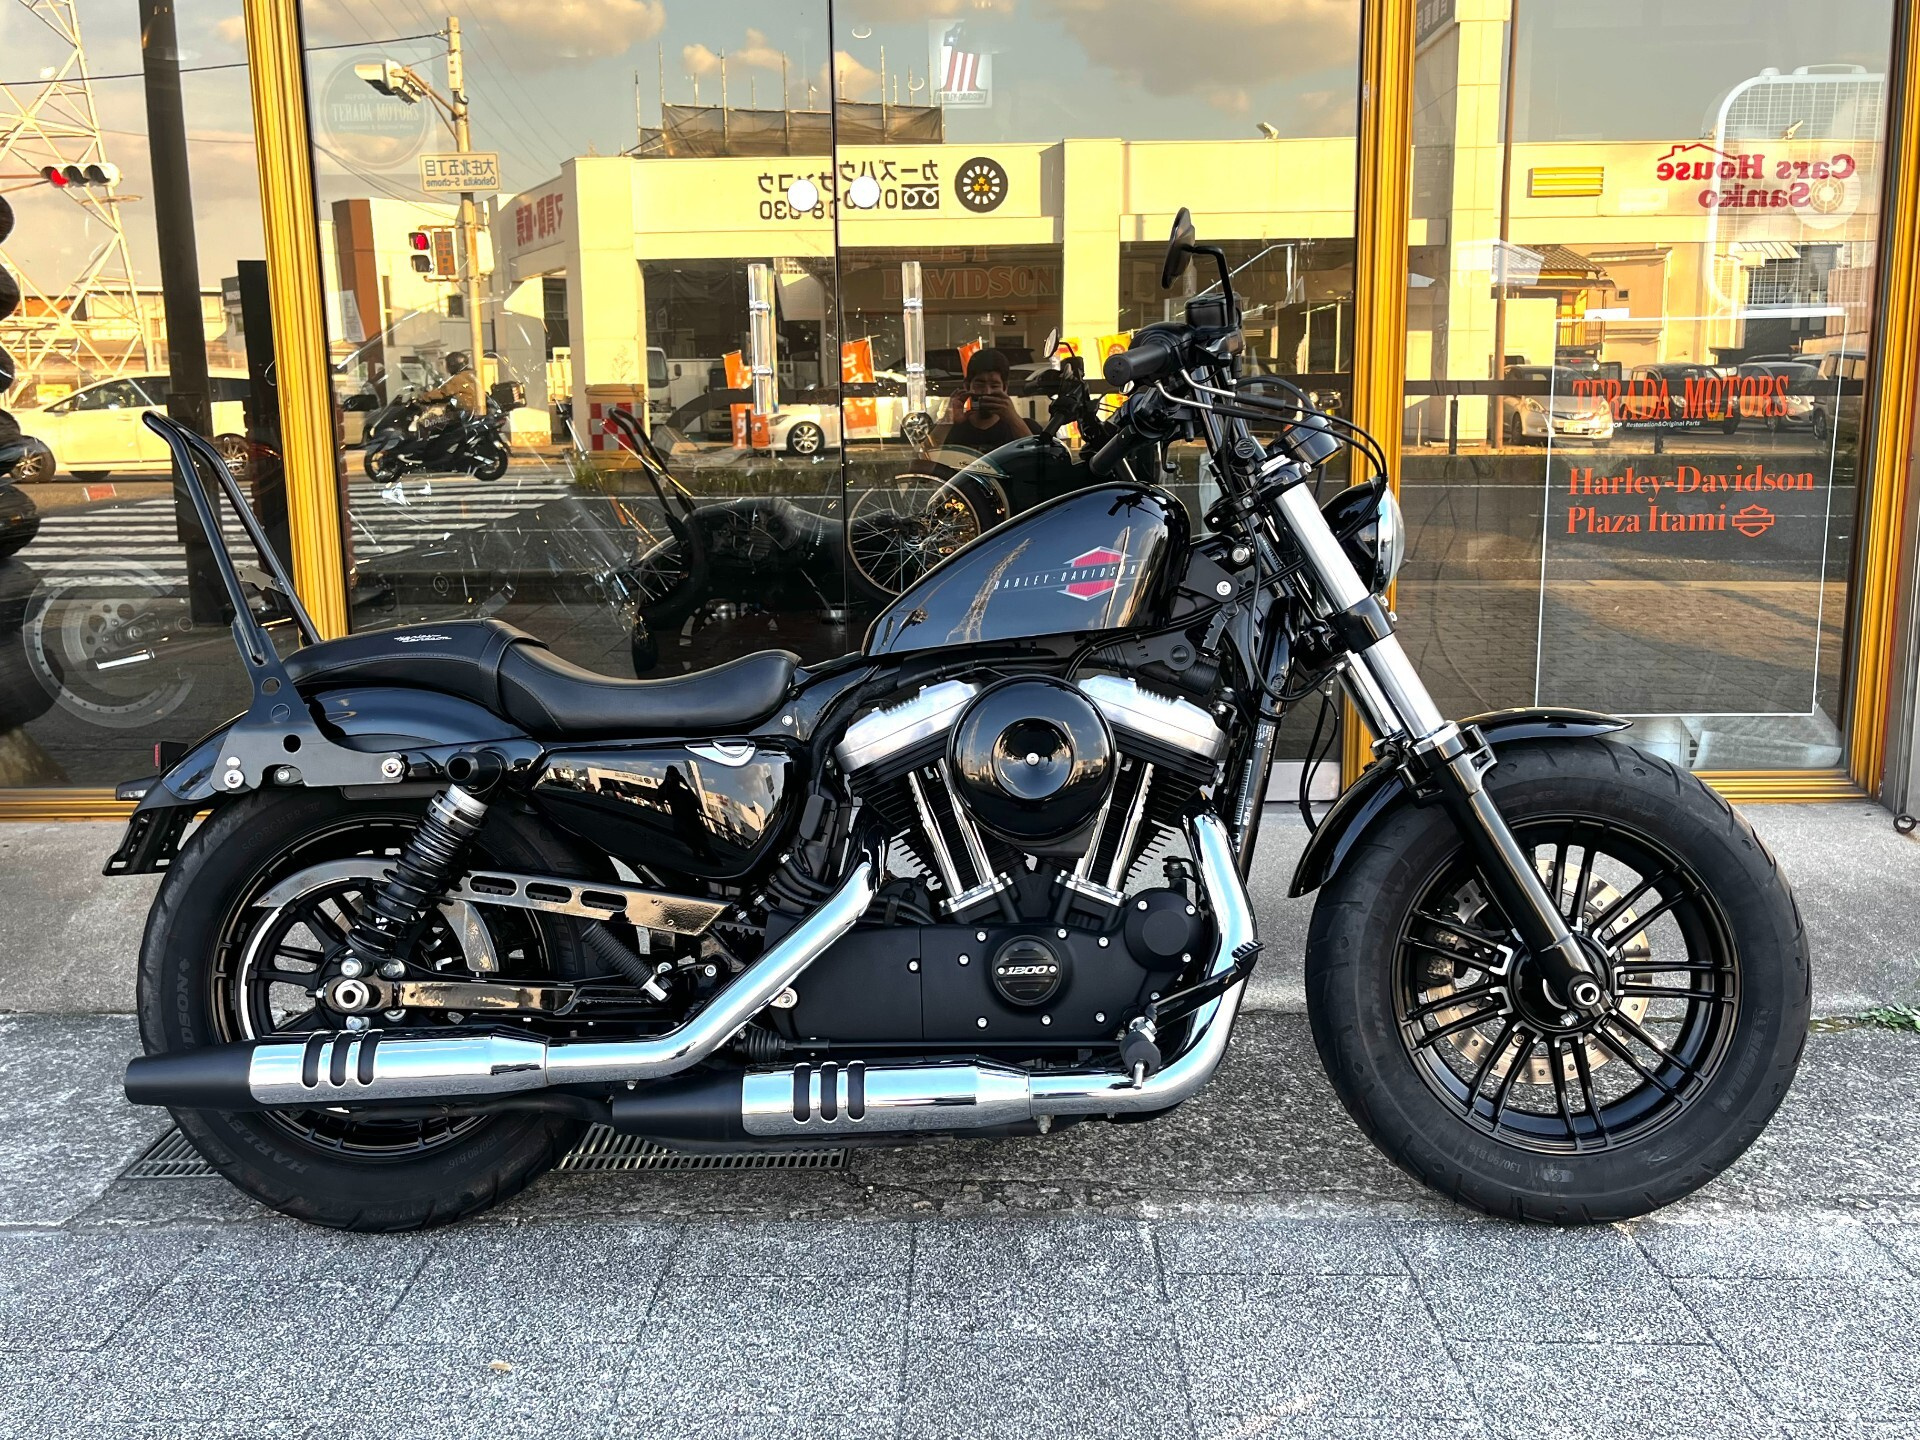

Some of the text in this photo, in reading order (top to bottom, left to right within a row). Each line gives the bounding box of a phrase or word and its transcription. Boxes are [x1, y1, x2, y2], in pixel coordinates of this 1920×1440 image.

[1572, 375, 1789, 421] TERADA MOTORS
[1567, 465, 1814, 502] Harley-Davidson
[1566, 503, 1726, 534] Plaza Itami
[1006, 966, 1048, 975] 1200
[176, 972, 196, 1049] DSON
